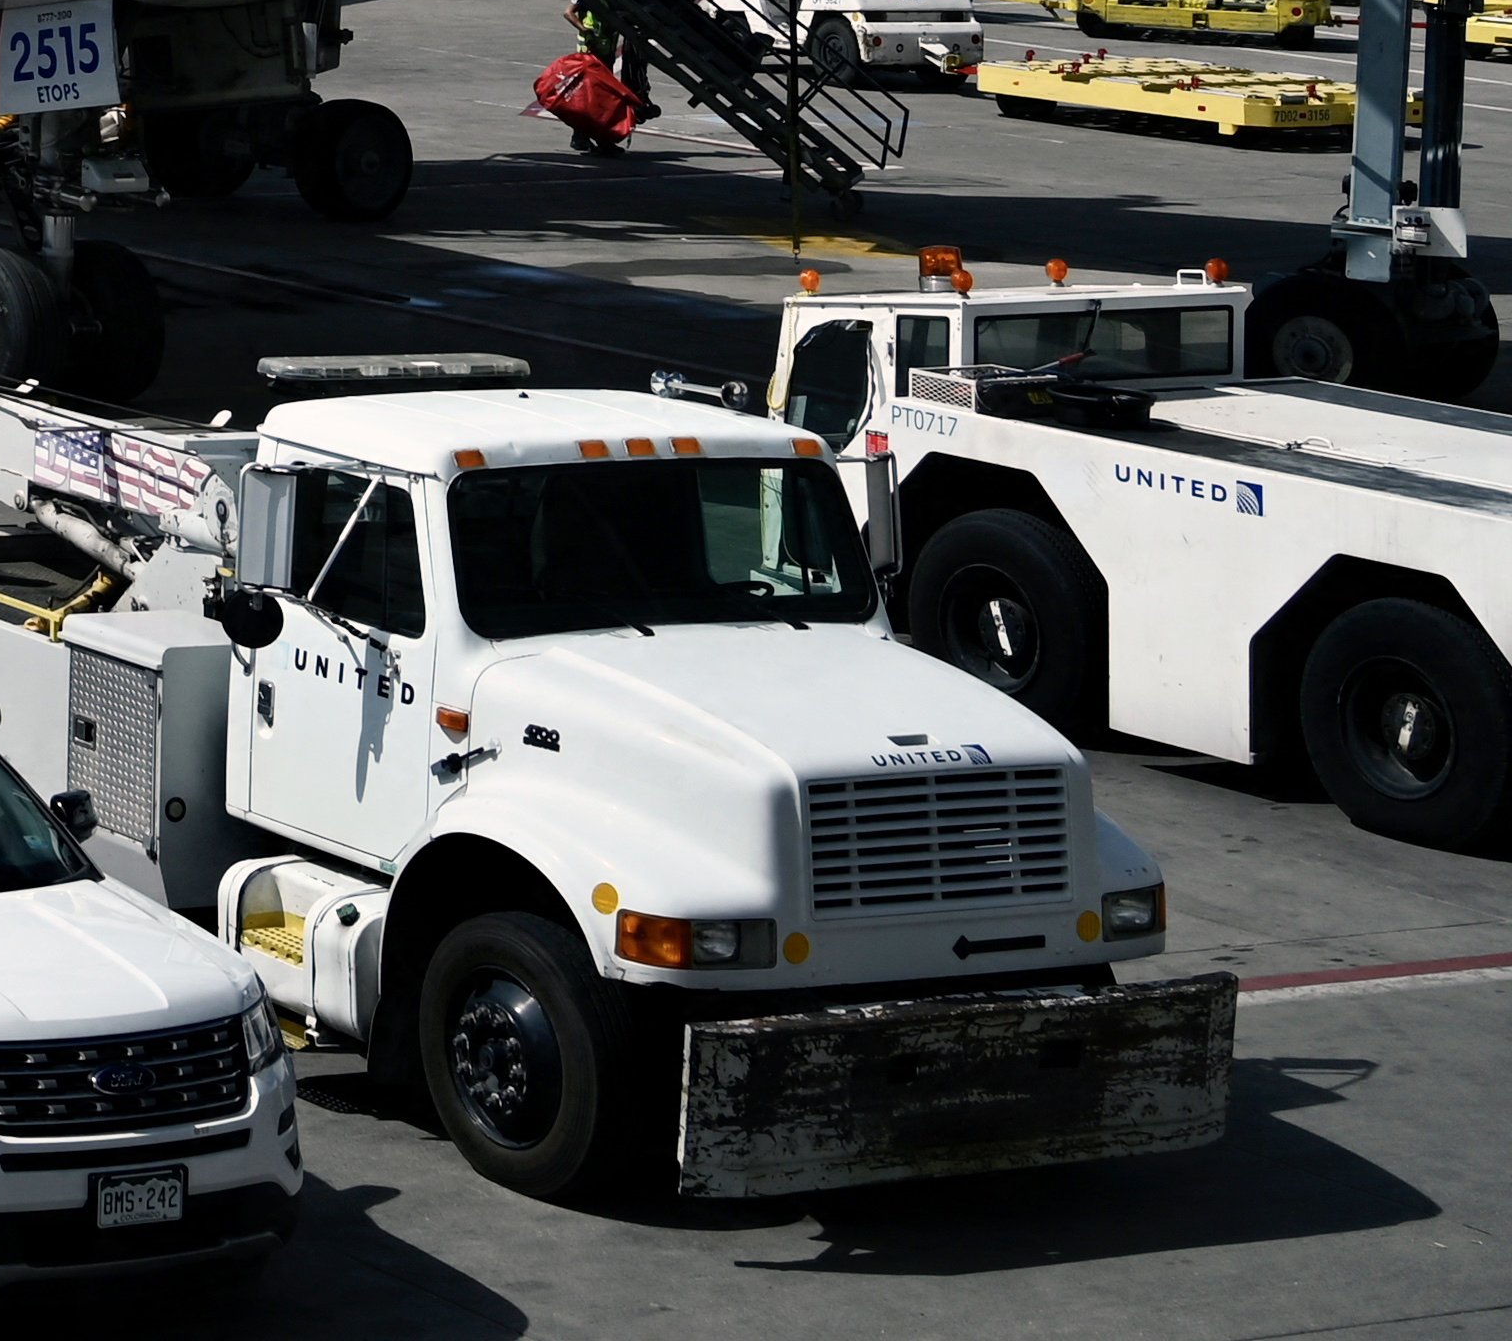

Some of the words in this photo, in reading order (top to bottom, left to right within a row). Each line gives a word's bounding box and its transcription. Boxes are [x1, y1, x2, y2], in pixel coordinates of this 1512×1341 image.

[10, 22, 100, 83] 2515
[36, 82, 80, 104] ETOPS
[891, 405, 958, 437] PT0717
[1115, 463, 1228, 503] UNITED
[294, 648, 415, 705] UNITED
[871, 749, 962, 767] UNITED
